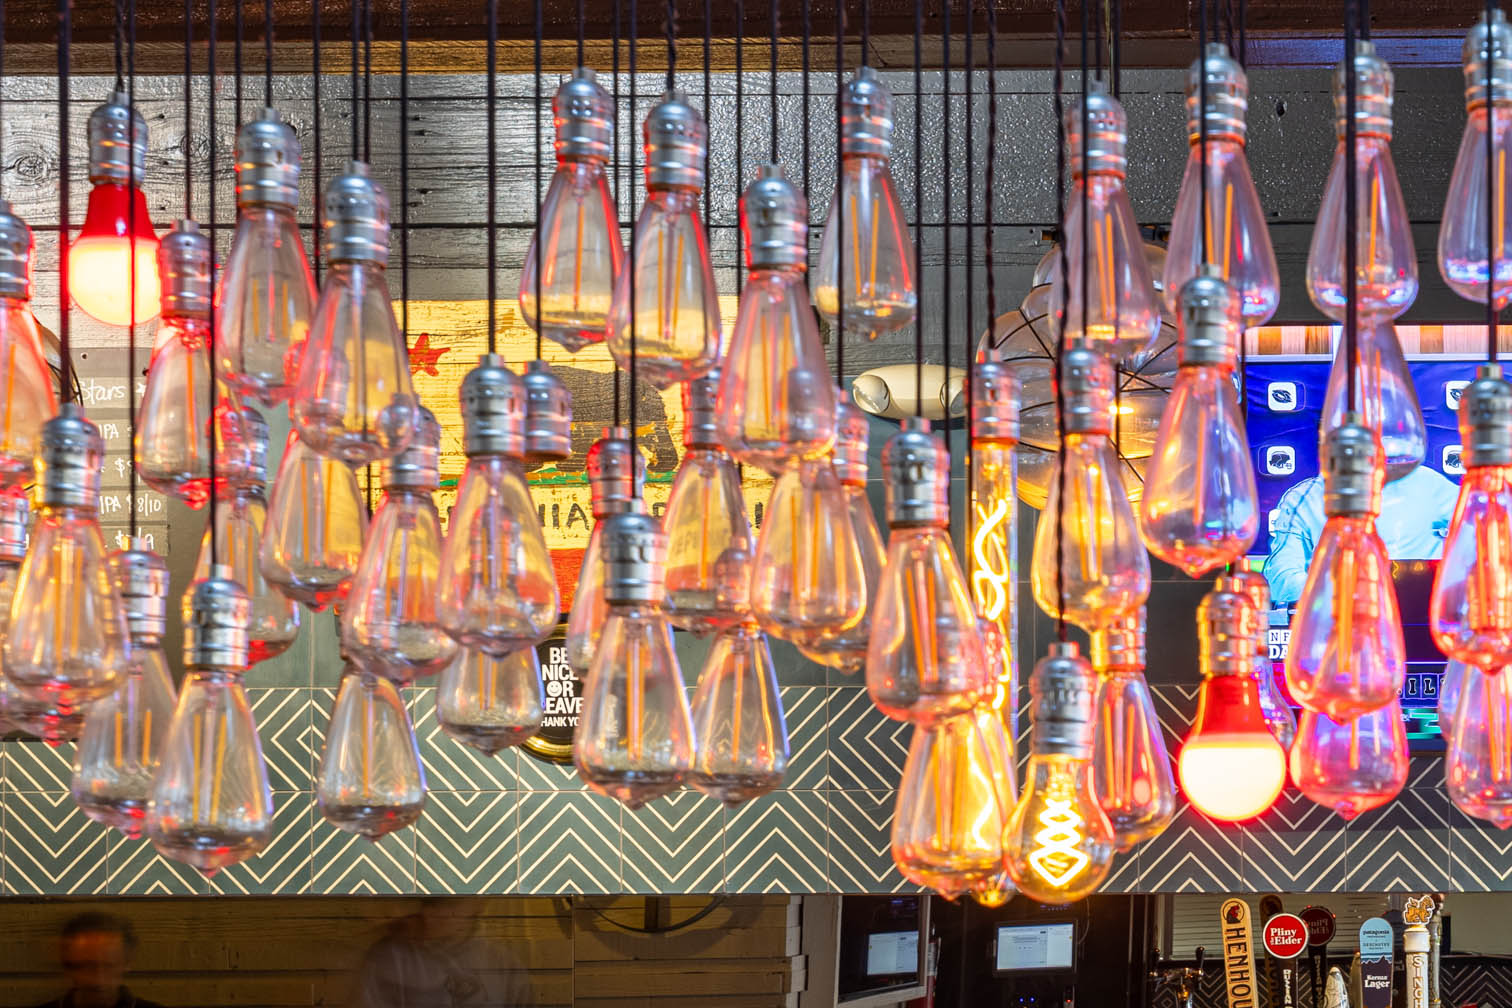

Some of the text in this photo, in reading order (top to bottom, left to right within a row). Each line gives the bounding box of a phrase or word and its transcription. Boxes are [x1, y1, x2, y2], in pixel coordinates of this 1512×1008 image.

[541, 716, 567, 727] HANK
[1270, 927, 1297, 937] Pliny
[1275, 935, 1303, 946] Elder
[1283, 969, 1293, 1005] RUSSIAN
[1364, 980, 1391, 990] Lager
